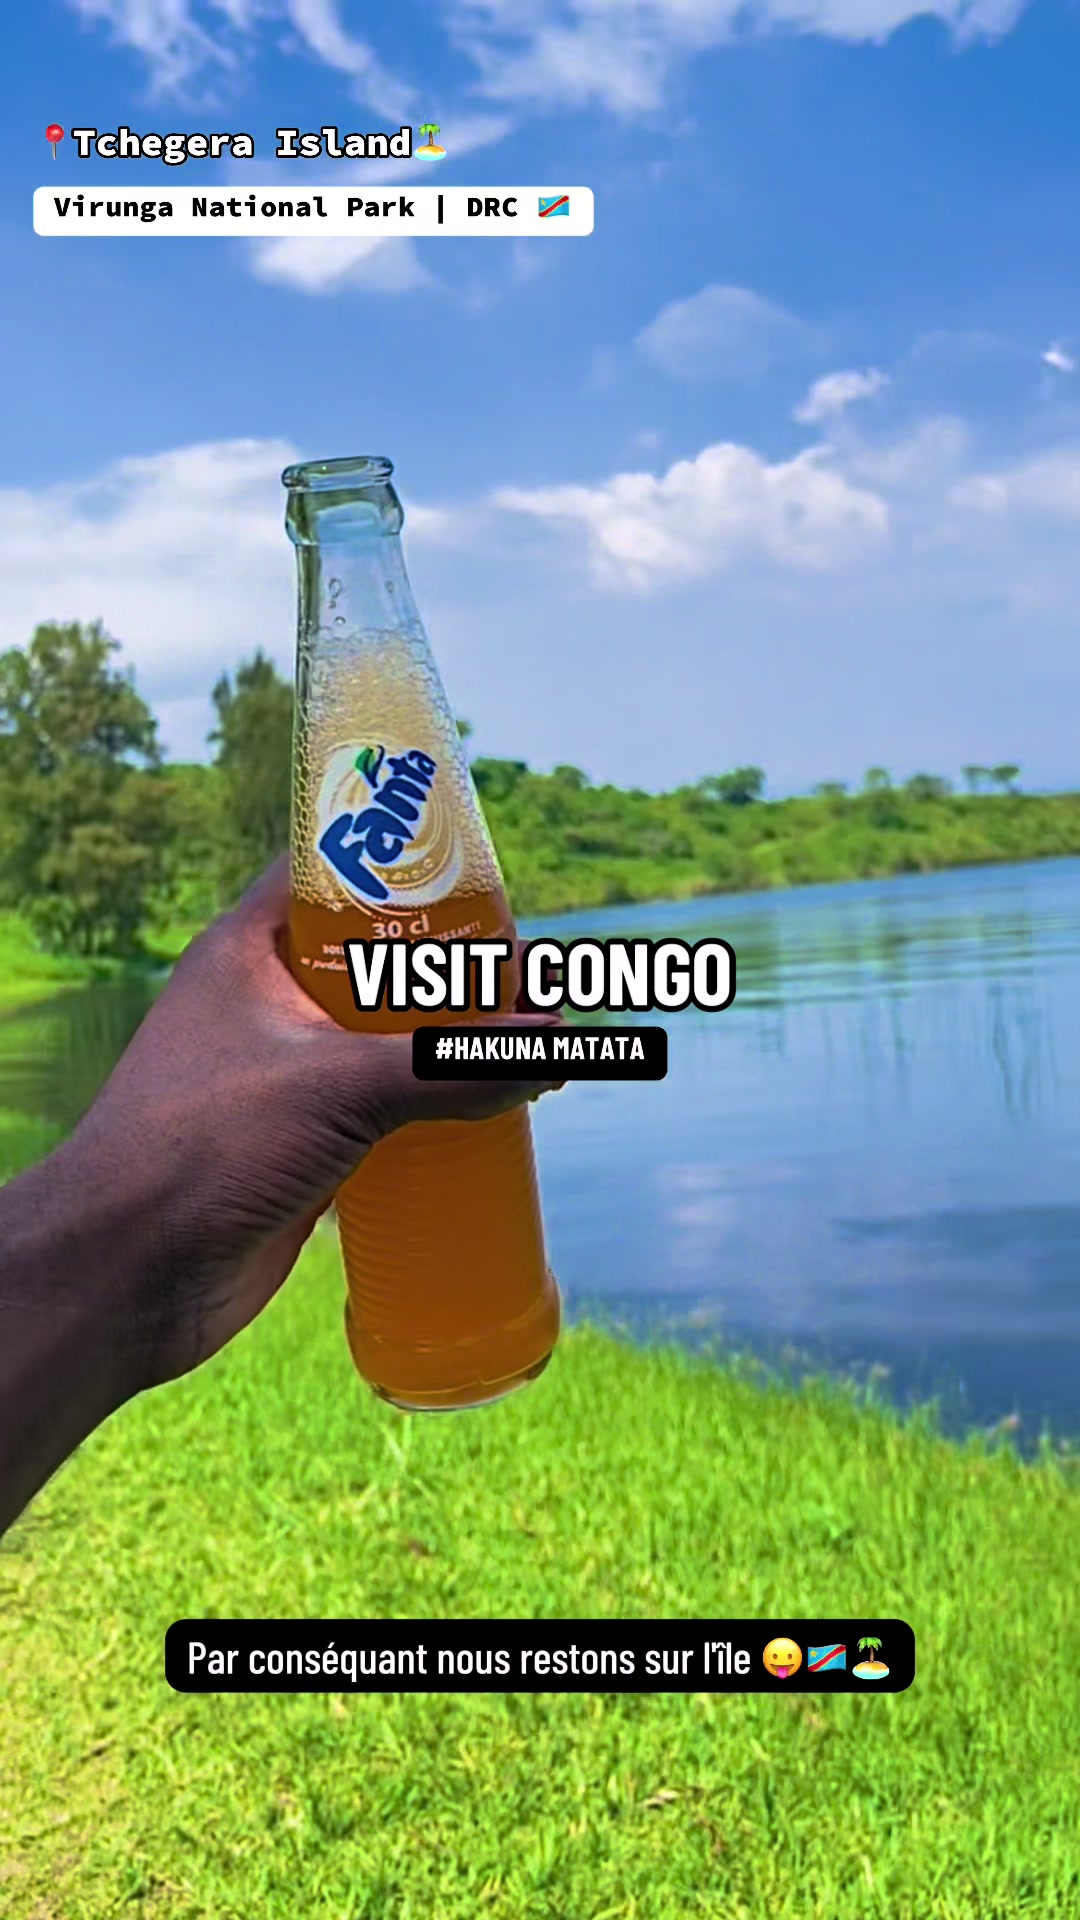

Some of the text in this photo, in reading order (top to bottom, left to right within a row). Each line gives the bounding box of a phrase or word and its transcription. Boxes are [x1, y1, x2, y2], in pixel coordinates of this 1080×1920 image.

[319, 748, 438, 901] Fanta
[371, 921, 403, 940] 30
[409, 913, 431, 935] cl
